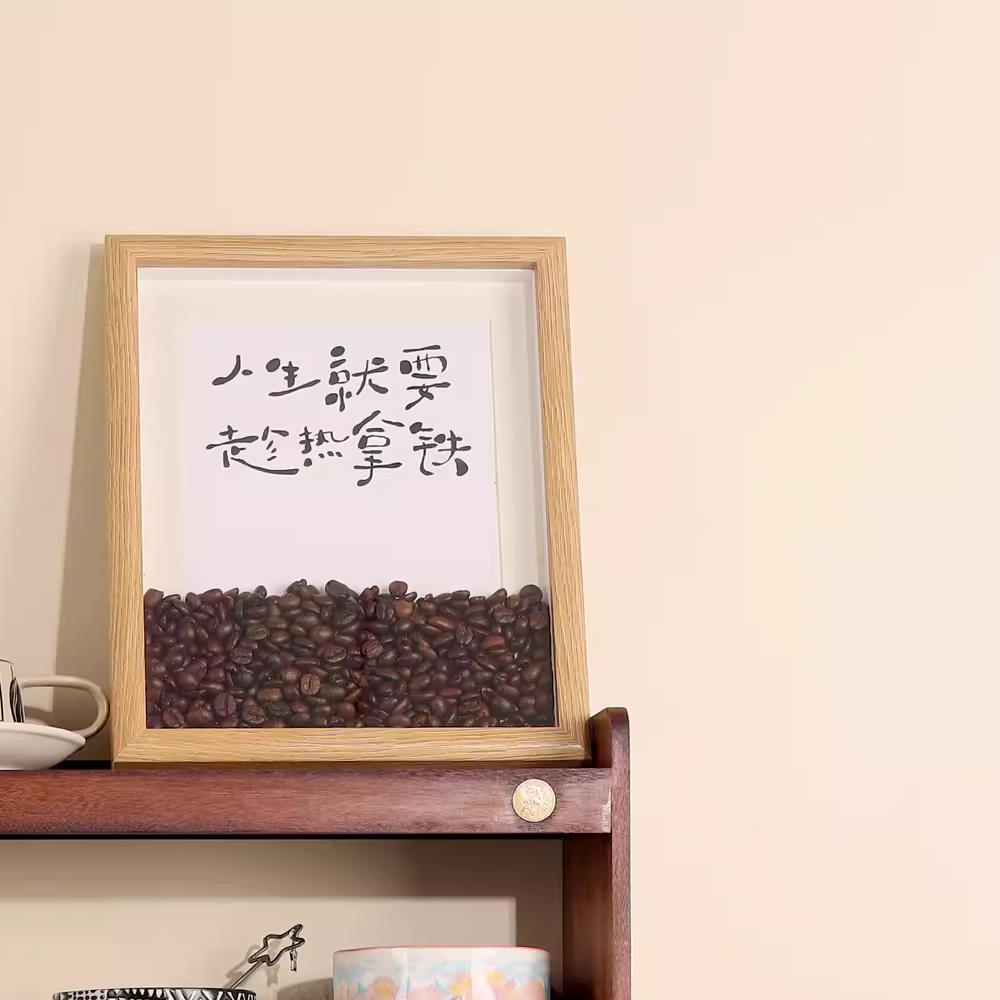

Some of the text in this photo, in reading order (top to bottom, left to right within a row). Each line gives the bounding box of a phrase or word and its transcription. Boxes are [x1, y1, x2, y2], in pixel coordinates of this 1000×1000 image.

[212, 345, 451, 412] 人生就要
[206, 410, 472, 486] 趁热拿铁
